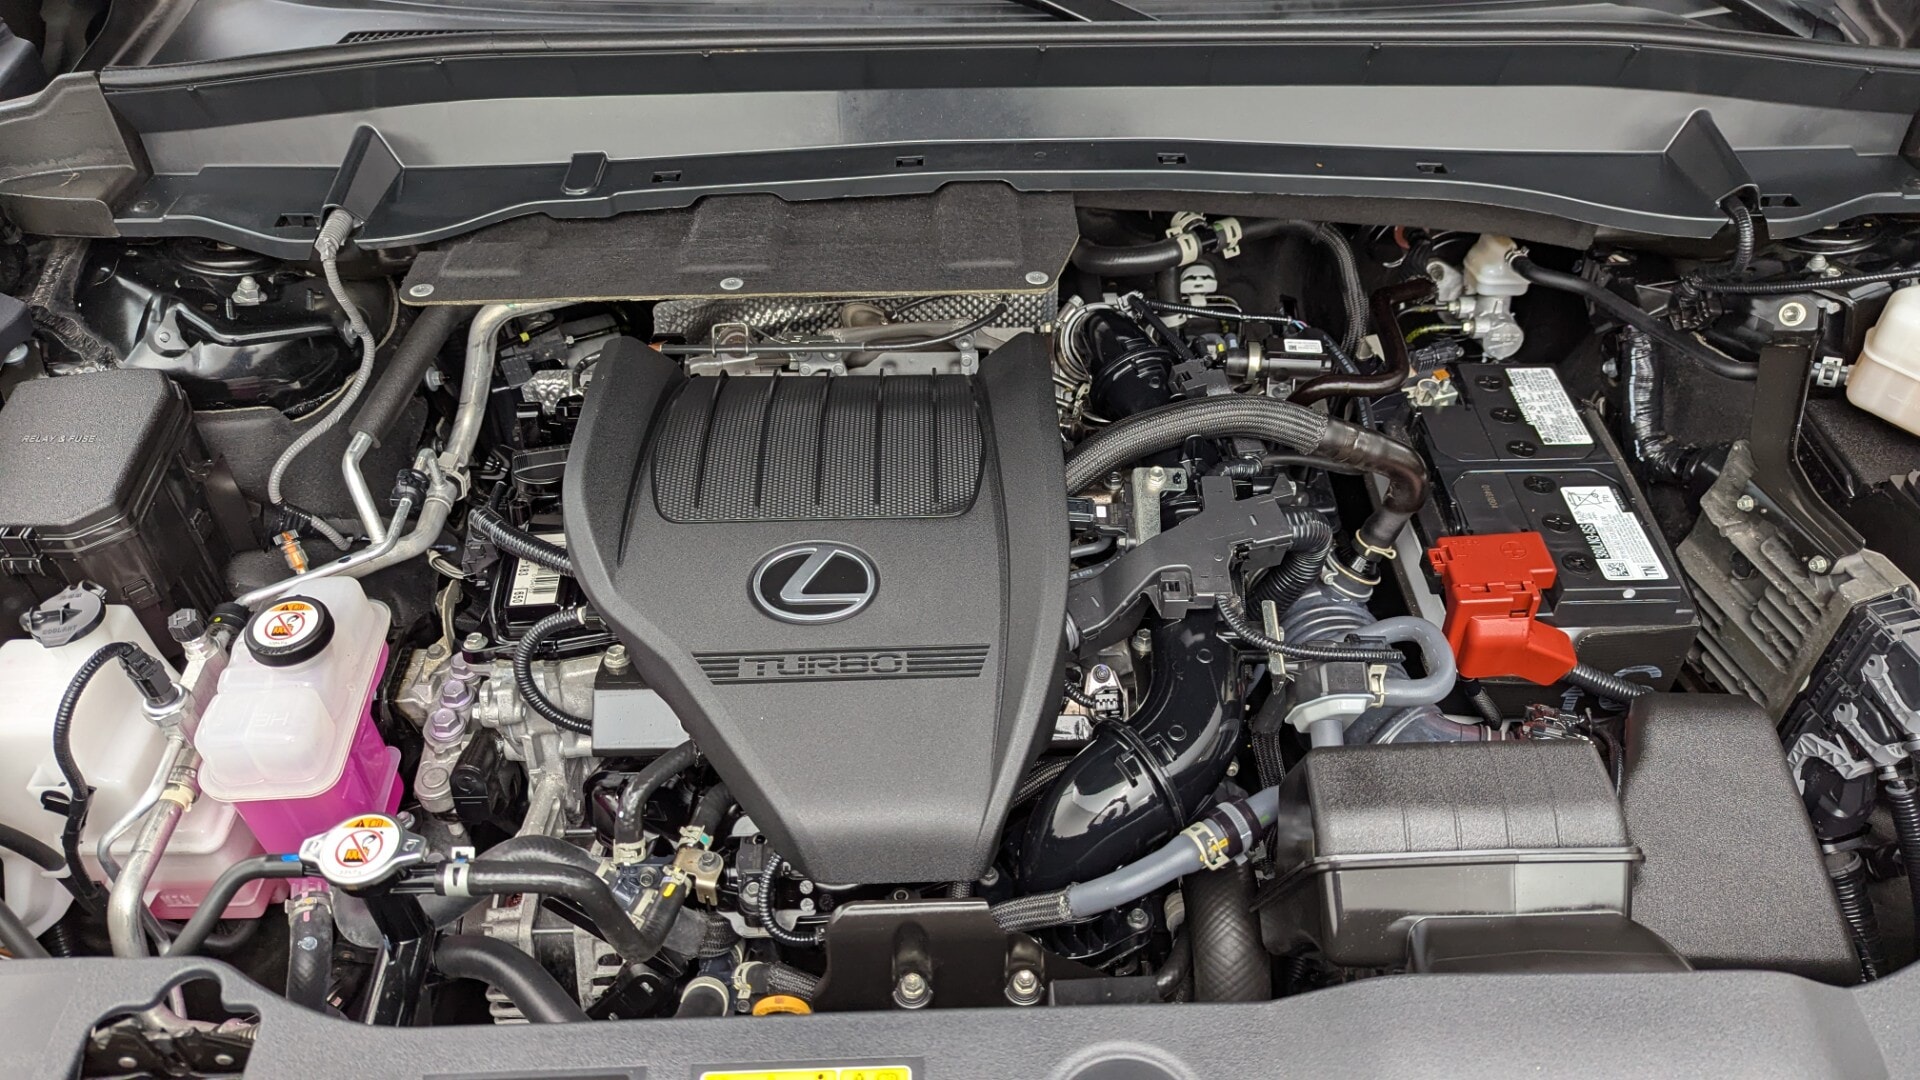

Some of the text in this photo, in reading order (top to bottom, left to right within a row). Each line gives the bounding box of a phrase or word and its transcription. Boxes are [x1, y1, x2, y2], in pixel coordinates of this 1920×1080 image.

[21, 434, 57, 443] RELAY
[67, 434, 97, 443] FUSE
[173, 610, 191, 626] H
[744, 652, 903, 677] TURBO
